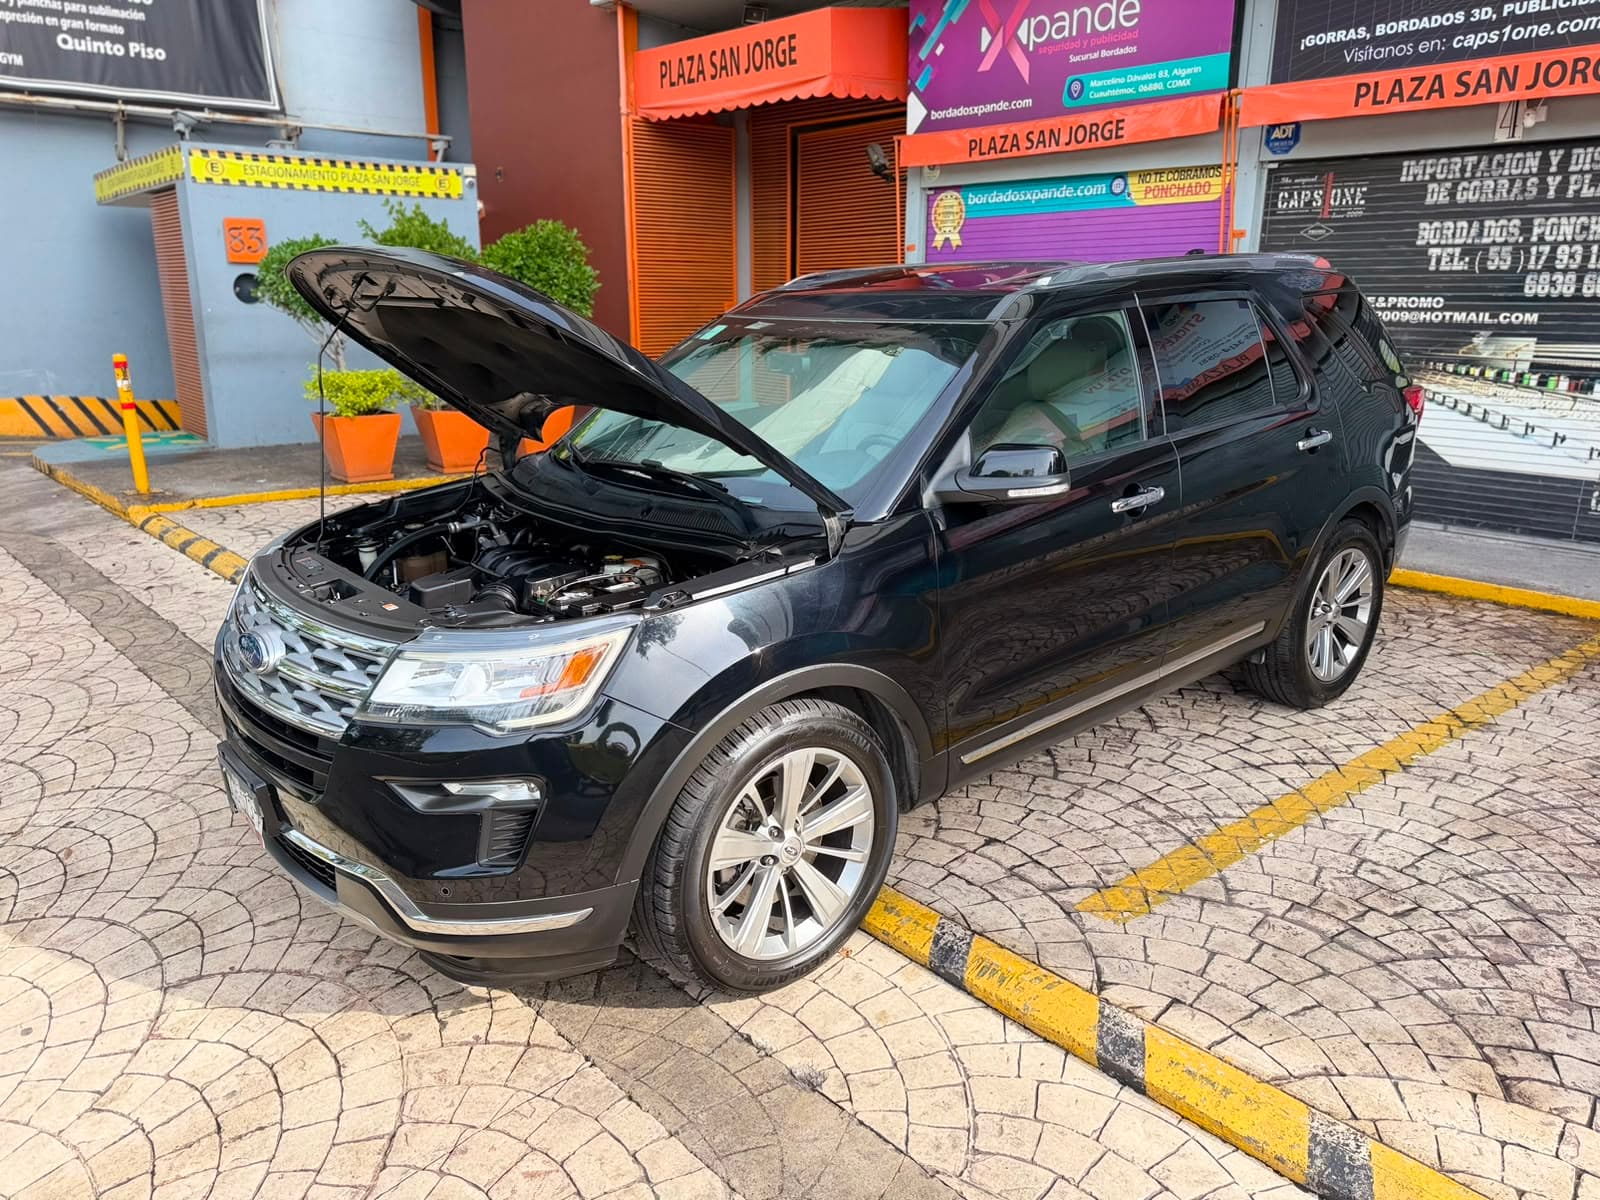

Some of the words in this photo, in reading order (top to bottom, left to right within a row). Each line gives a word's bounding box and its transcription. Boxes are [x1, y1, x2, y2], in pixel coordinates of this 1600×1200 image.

[64, 2, 87, 13] para
[89, 4, 146, 21] sublimación
[45, 16, 58, 26] en
[60, 19, 84, 30] gran
[85, 19, 125, 35] formato
[1300, 26, 1371, 50] ¡GORRAS,
[1375, 11, 1465, 37] BORDADOS
[1470, 6, 1497, 22] 3D,
[1503, 0, 1600, 17] PUBLIC
[56, 33, 125, 57] Quinto
[128, 42, 167, 61] Piso
[1038, 40, 1081, 55] seguridad
[1082, 39, 1089, 49] y
[1090, 30, 1139, 48] publicidad
[1343, 43, 1414, 63] Visítanos
[1418, 38, 1447, 51] en:
[1452, 16, 1600, 50] caps1one.com
[0, 52, 24, 66] GYM
[659, 54, 706, 89] PLAZA
[710, 45, 741, 80] SAN
[744, 33, 797, 74] JORGE
[1069, 51, 1100, 63] Sucursal
[1100, 45, 1137, 58] Bordados
[1354, 74, 1445, 108] PLAZA
[1453, 64, 1519, 98] SAN
[1525, 56, 1600, 91] JOR
[930, 97, 1033, 120] bordadosxpande.com
[968, 131, 1021, 158] PLAZA
[1025, 128, 1061, 151] SAN
[1065, 119, 1126, 147] JORGE
[1270, 124, 1295, 140] ADT
[243, 164, 339, 182] ESTACIONAMIENTO
[341, 171, 370, 185] PLAZA
[372, 173, 391, 186] SAN
[391, 175, 421, 188] JORGE
[1137, 172, 1152, 185] NO
[1154, 171, 1165, 183] TE
[1166, 166, 1222, 182] COBRAMOS
[1400, 151, 1542, 182] IMPORTACION
[1549, 149, 1565, 173] Y
[967, 182, 1107, 206] bordadosxpande.com
[1144, 181, 1212, 200] PONCHADO
[1424, 181, 1452, 205] DE
[1456, 177, 1540, 204] GORRAS
[1546, 175, 1563, 199] Y
[1416, 218, 1524, 246] BORDADOS,
[1428, 246, 1470, 272] TEL:
[1555, 244, 1584, 270] 93
[1524, 271, 1577, 298] 6838
